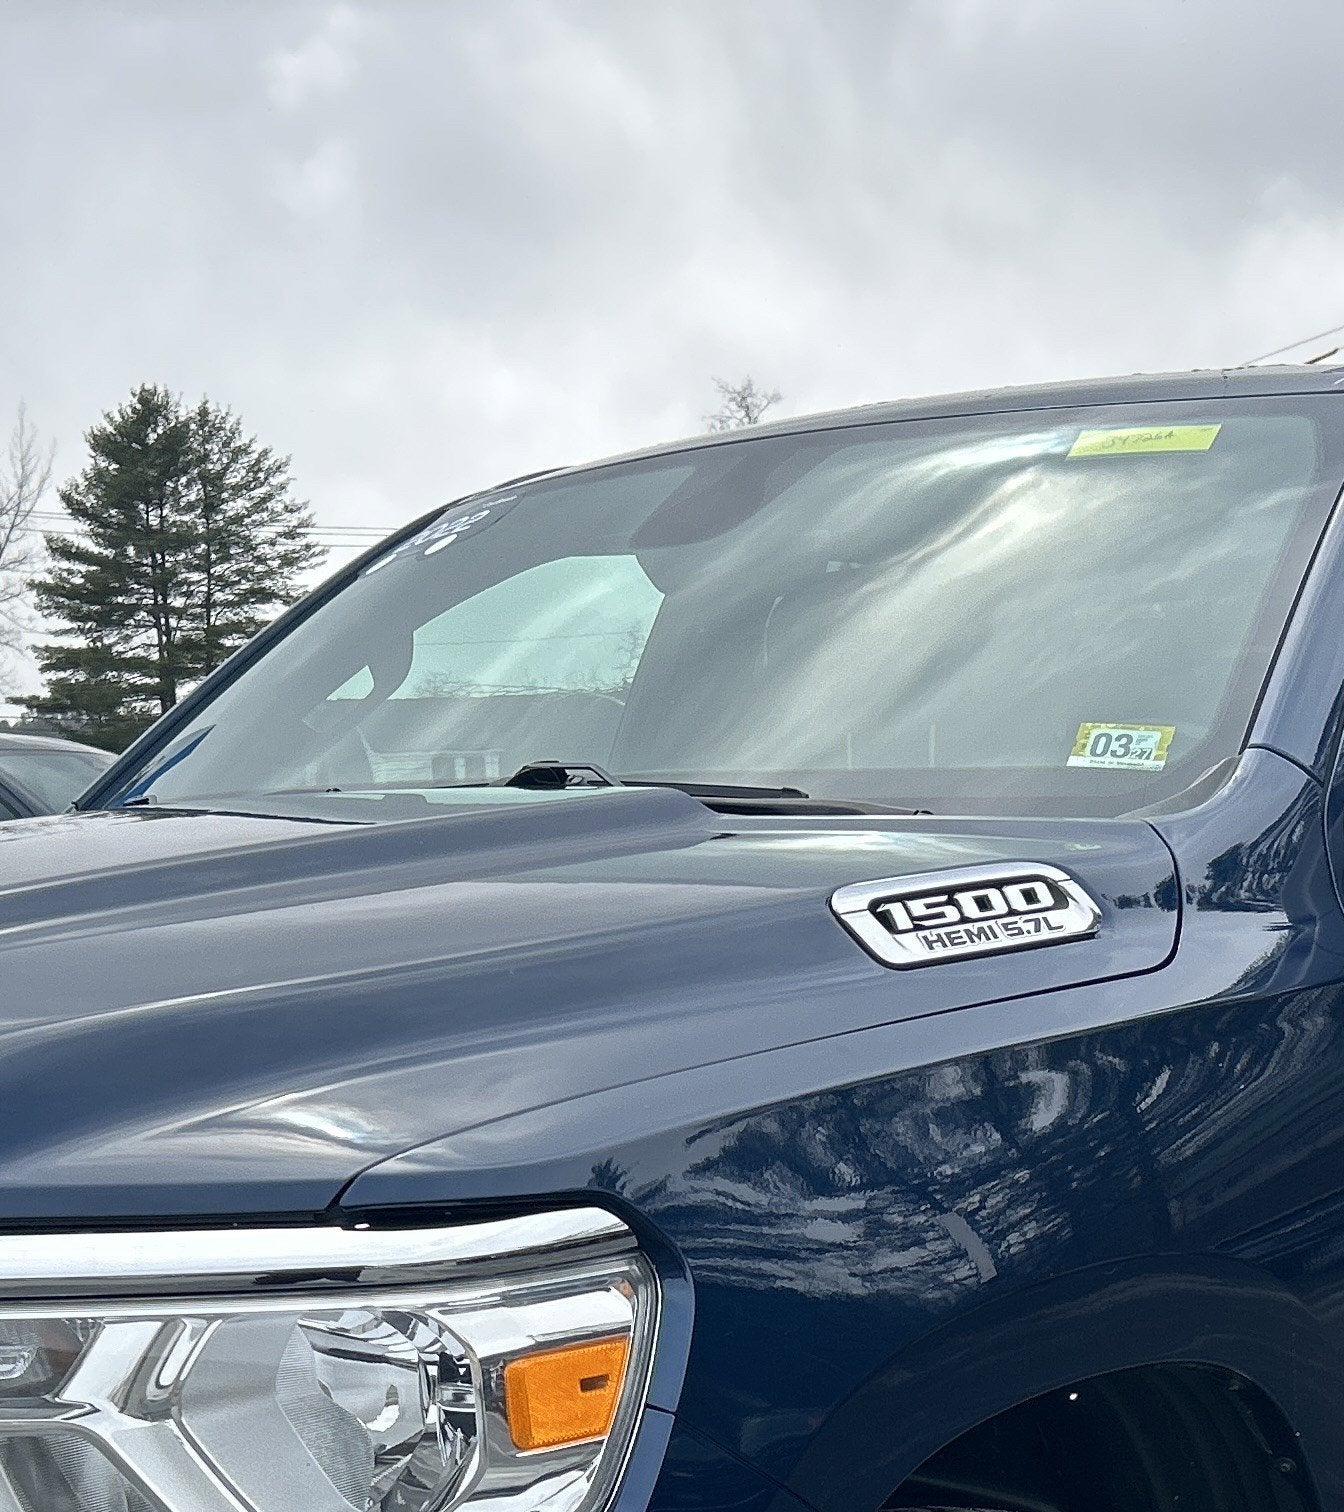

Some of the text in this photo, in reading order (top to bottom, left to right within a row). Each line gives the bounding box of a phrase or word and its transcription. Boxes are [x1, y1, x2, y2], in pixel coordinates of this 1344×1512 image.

[1089, 732, 1134, 759] 03
[1128, 747, 1154, 760] 27
[876, 881, 1055, 931] 1500
[922, 914, 1063, 951] HEMI 5.7L
